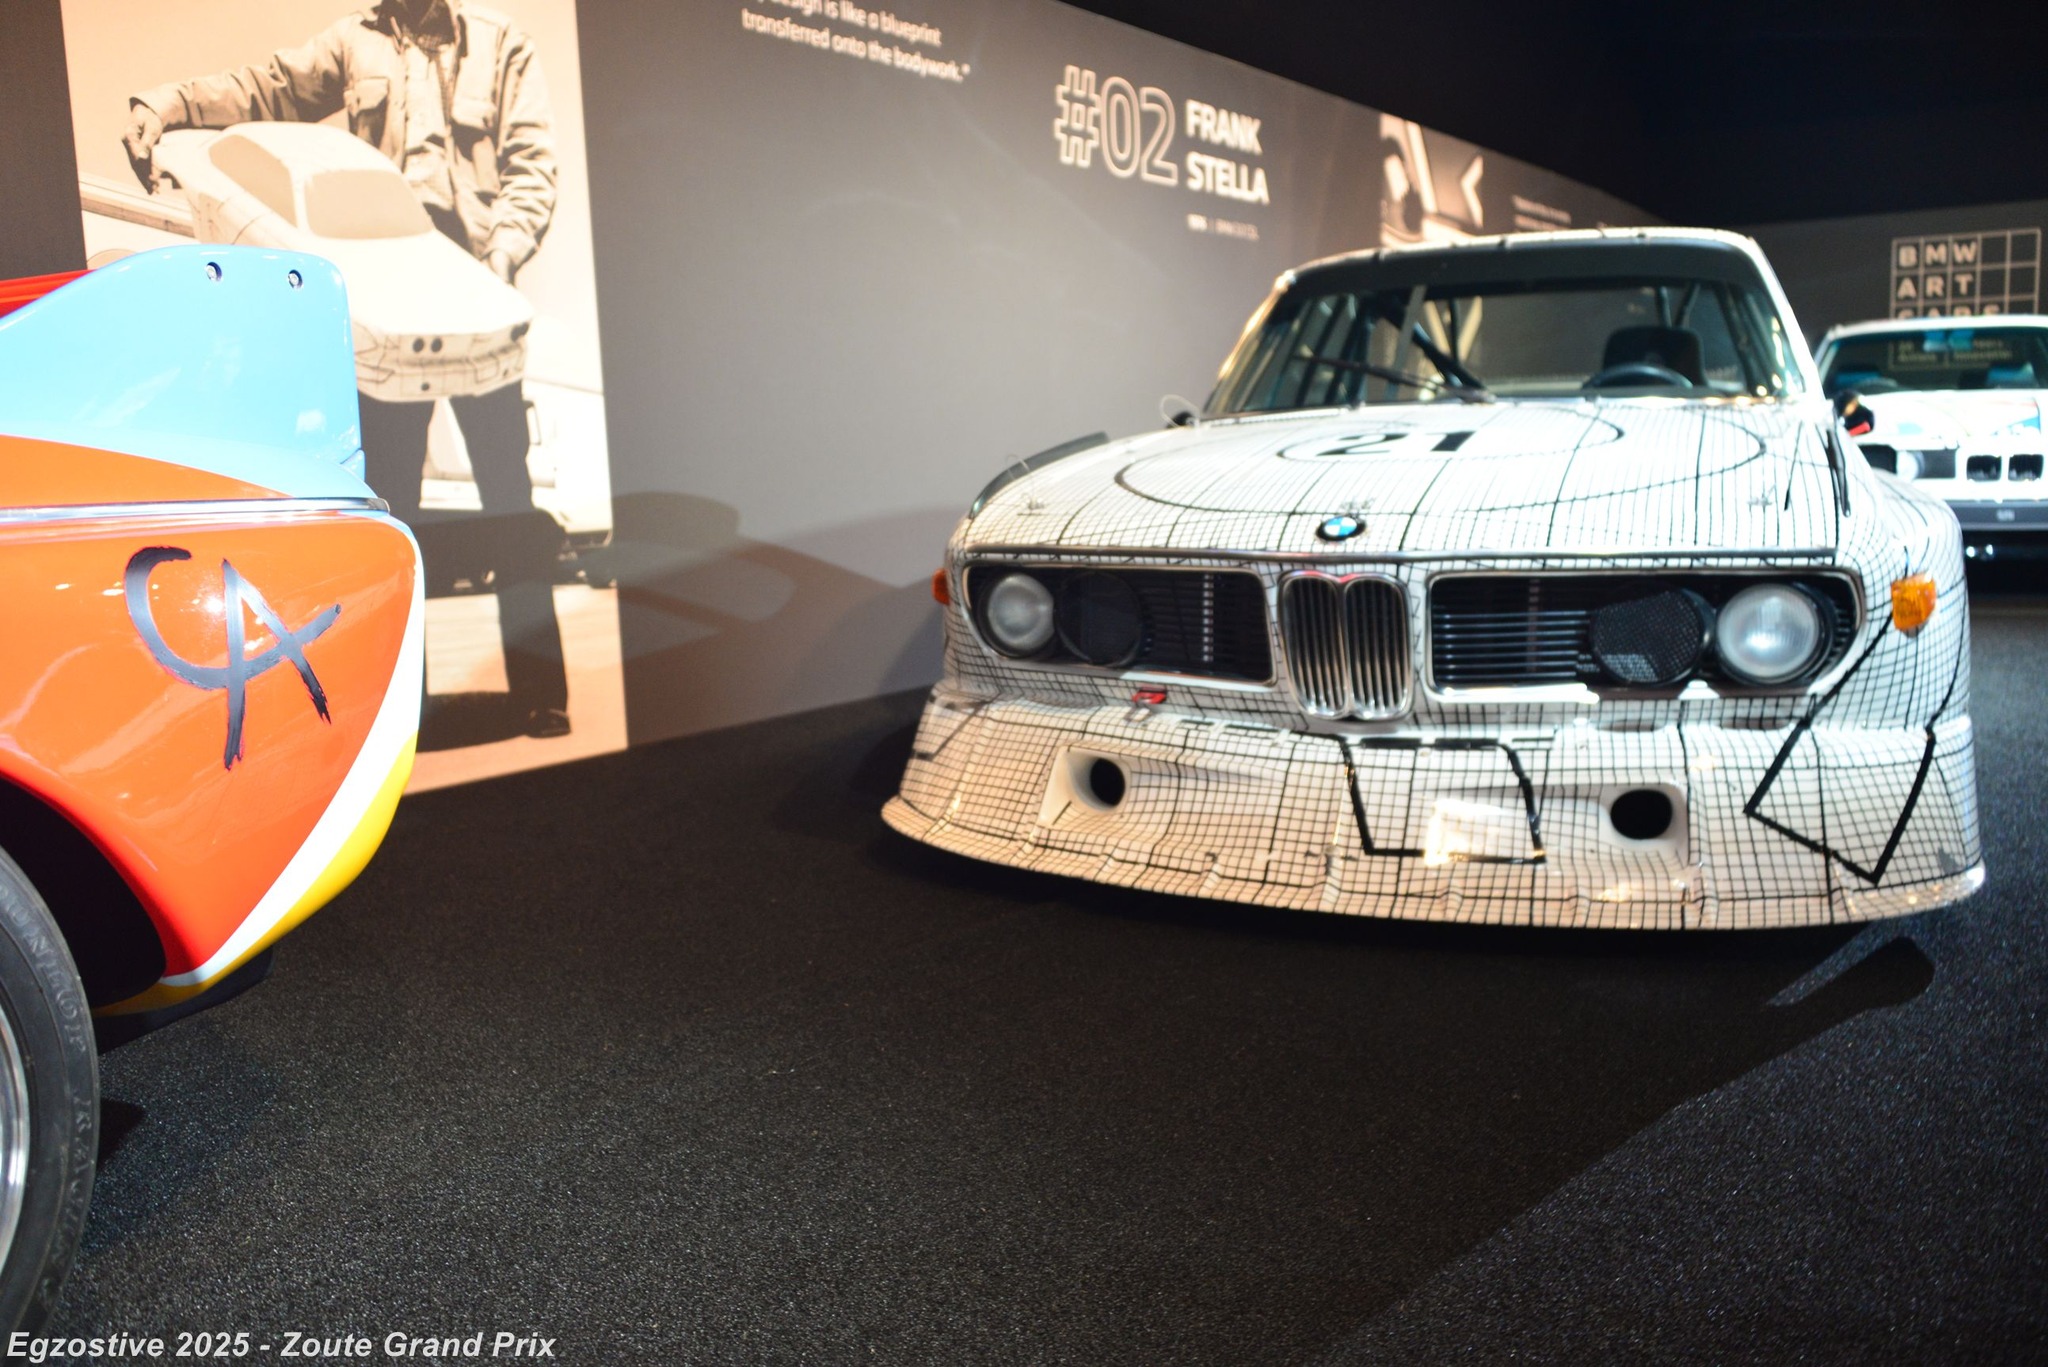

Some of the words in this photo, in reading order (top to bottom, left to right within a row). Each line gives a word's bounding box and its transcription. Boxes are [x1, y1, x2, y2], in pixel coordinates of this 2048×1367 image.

[741, 8, 830, 49] transferred
[831, 33, 867, 59] onto
[868, 40, 893, 65] the
[841, 0, 867, 27] like
[880, 11, 942, 48] blueprint
[1054, 64, 1179, 187] #02
[1186, 99, 1263, 155] FRANK
[1186, 151, 1270, 205] STELLA
[1899, 241, 1977, 267] BMW
[1898, 273, 1974, 299] ART
[1315, 430, 1477, 457] 21
